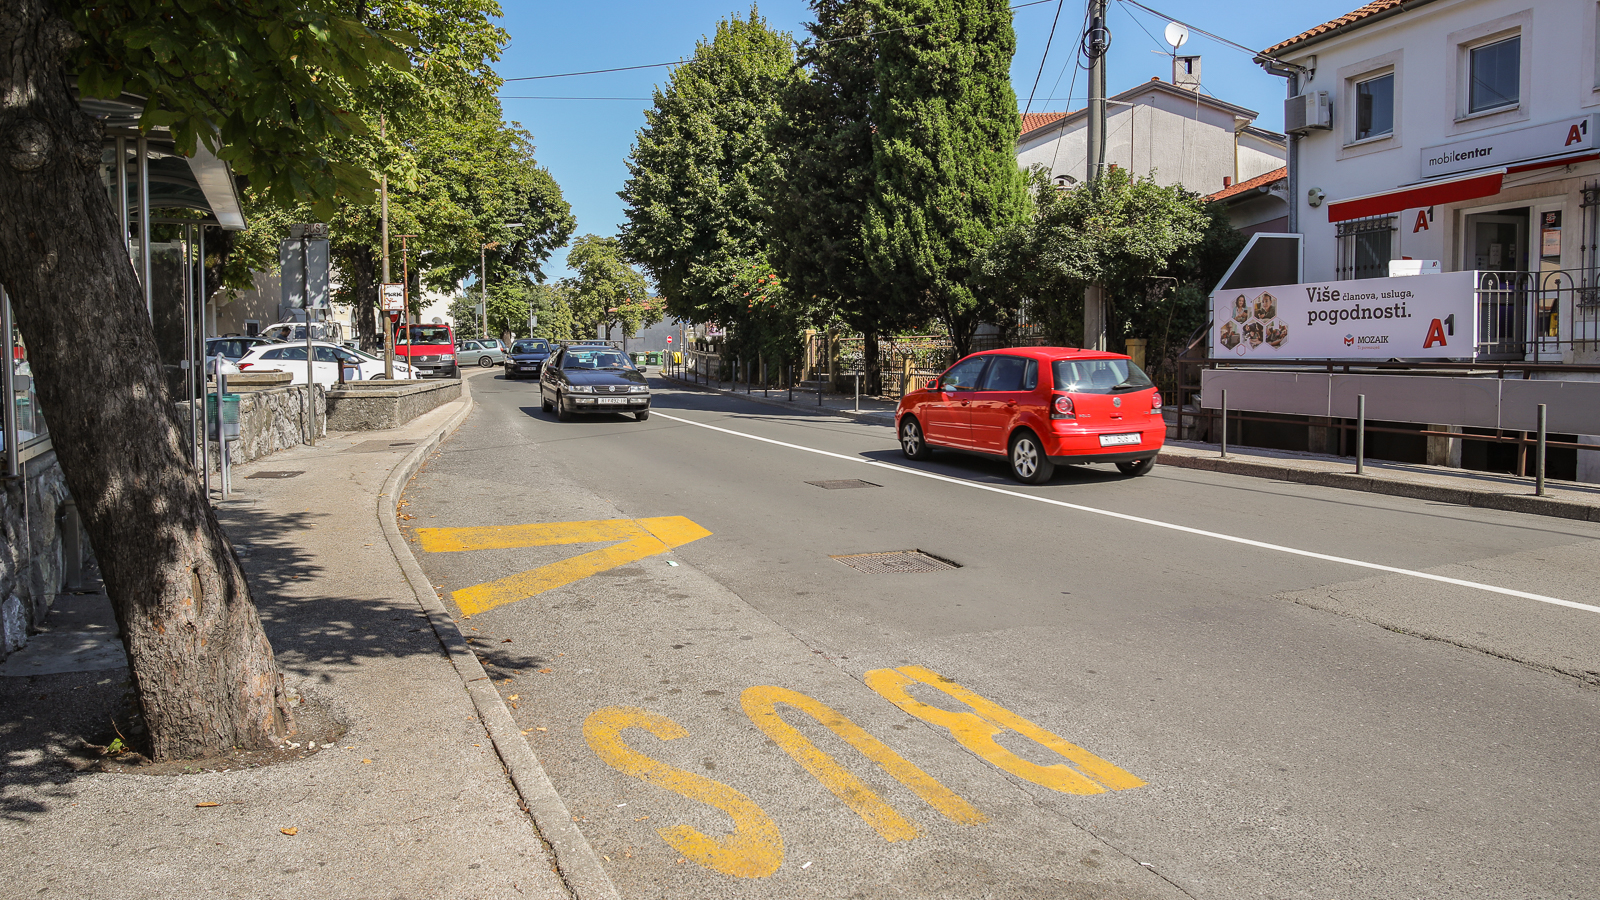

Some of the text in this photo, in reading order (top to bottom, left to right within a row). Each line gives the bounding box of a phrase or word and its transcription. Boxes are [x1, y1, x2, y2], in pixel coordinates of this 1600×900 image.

[1565, 119, 1588, 147] A1
[1429, 147, 1493, 166] mobilcentar
[304, 223, 320, 234] BUS
[1413, 206, 1434, 233] A1
[1306, 286, 1415, 303] Više članova, usluga,
[1307, 302, 1412, 326] pogodnosti.
[1357, 335, 1389, 344] MOZAIK
[1423, 313, 1455, 349] A1
[583, 665, 1149, 878] BUS
